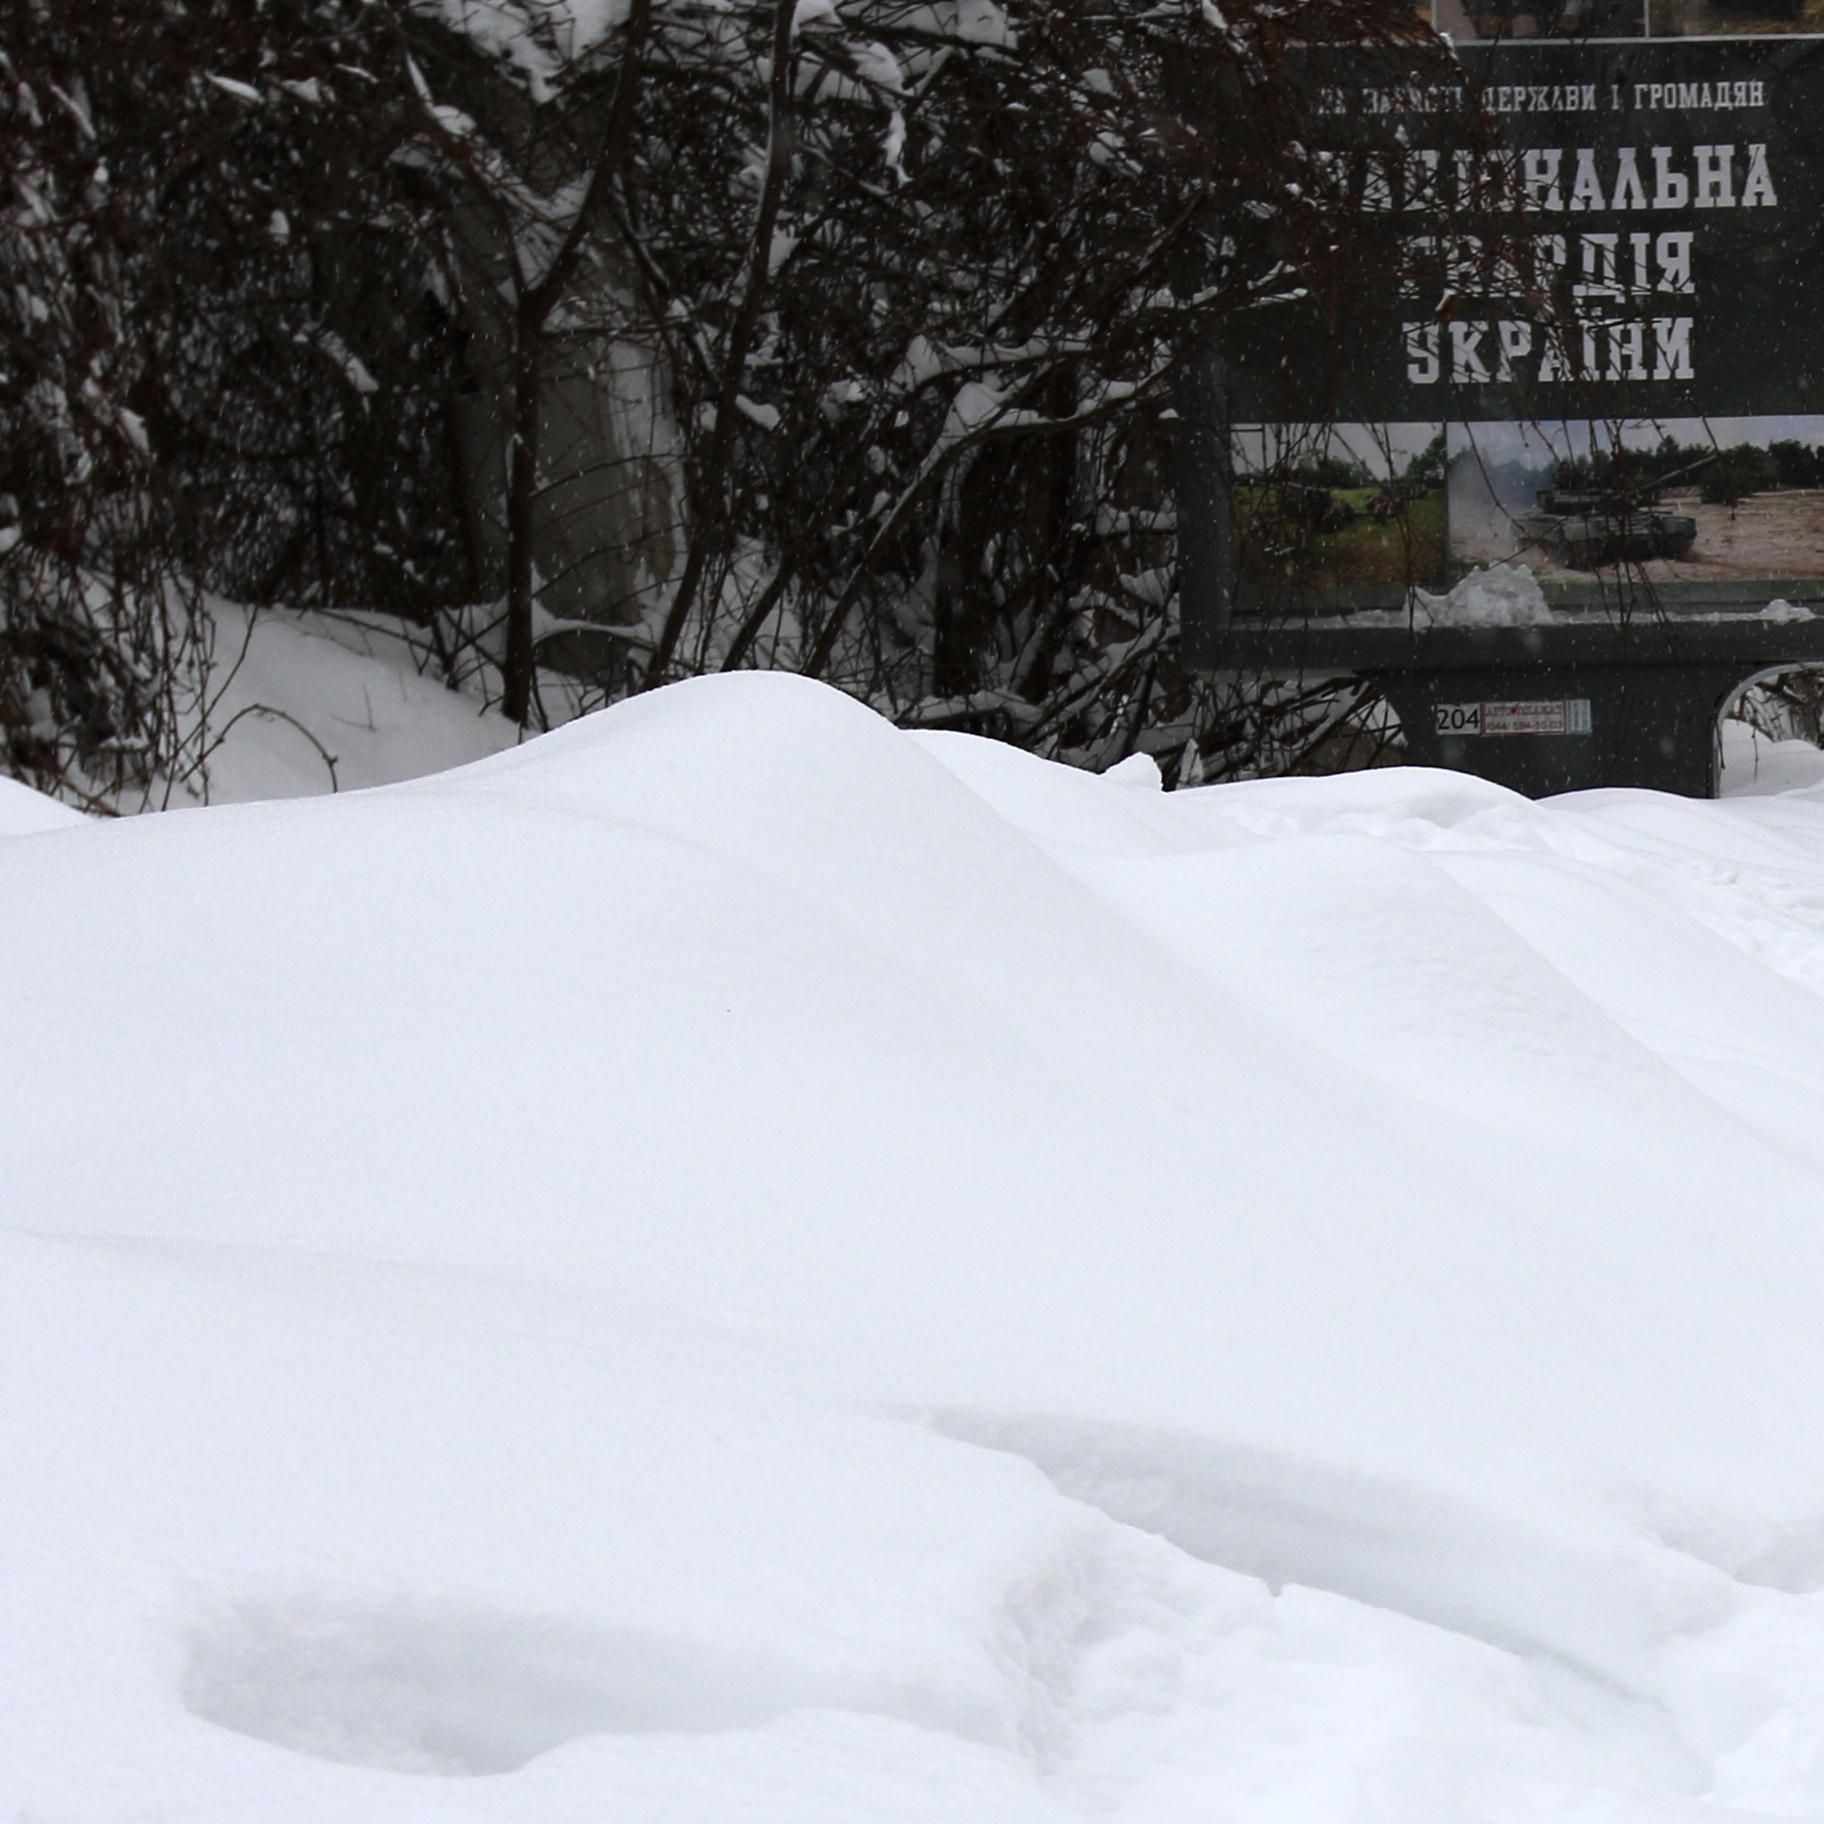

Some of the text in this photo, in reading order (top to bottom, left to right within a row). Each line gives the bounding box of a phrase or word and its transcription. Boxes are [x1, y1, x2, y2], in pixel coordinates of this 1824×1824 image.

[1634, 80, 1767, 111] ГРОМАДЯН
[1402, 306, 1696, 385] УКРАЇНИ
[1437, 708, 1480, 730] 204
